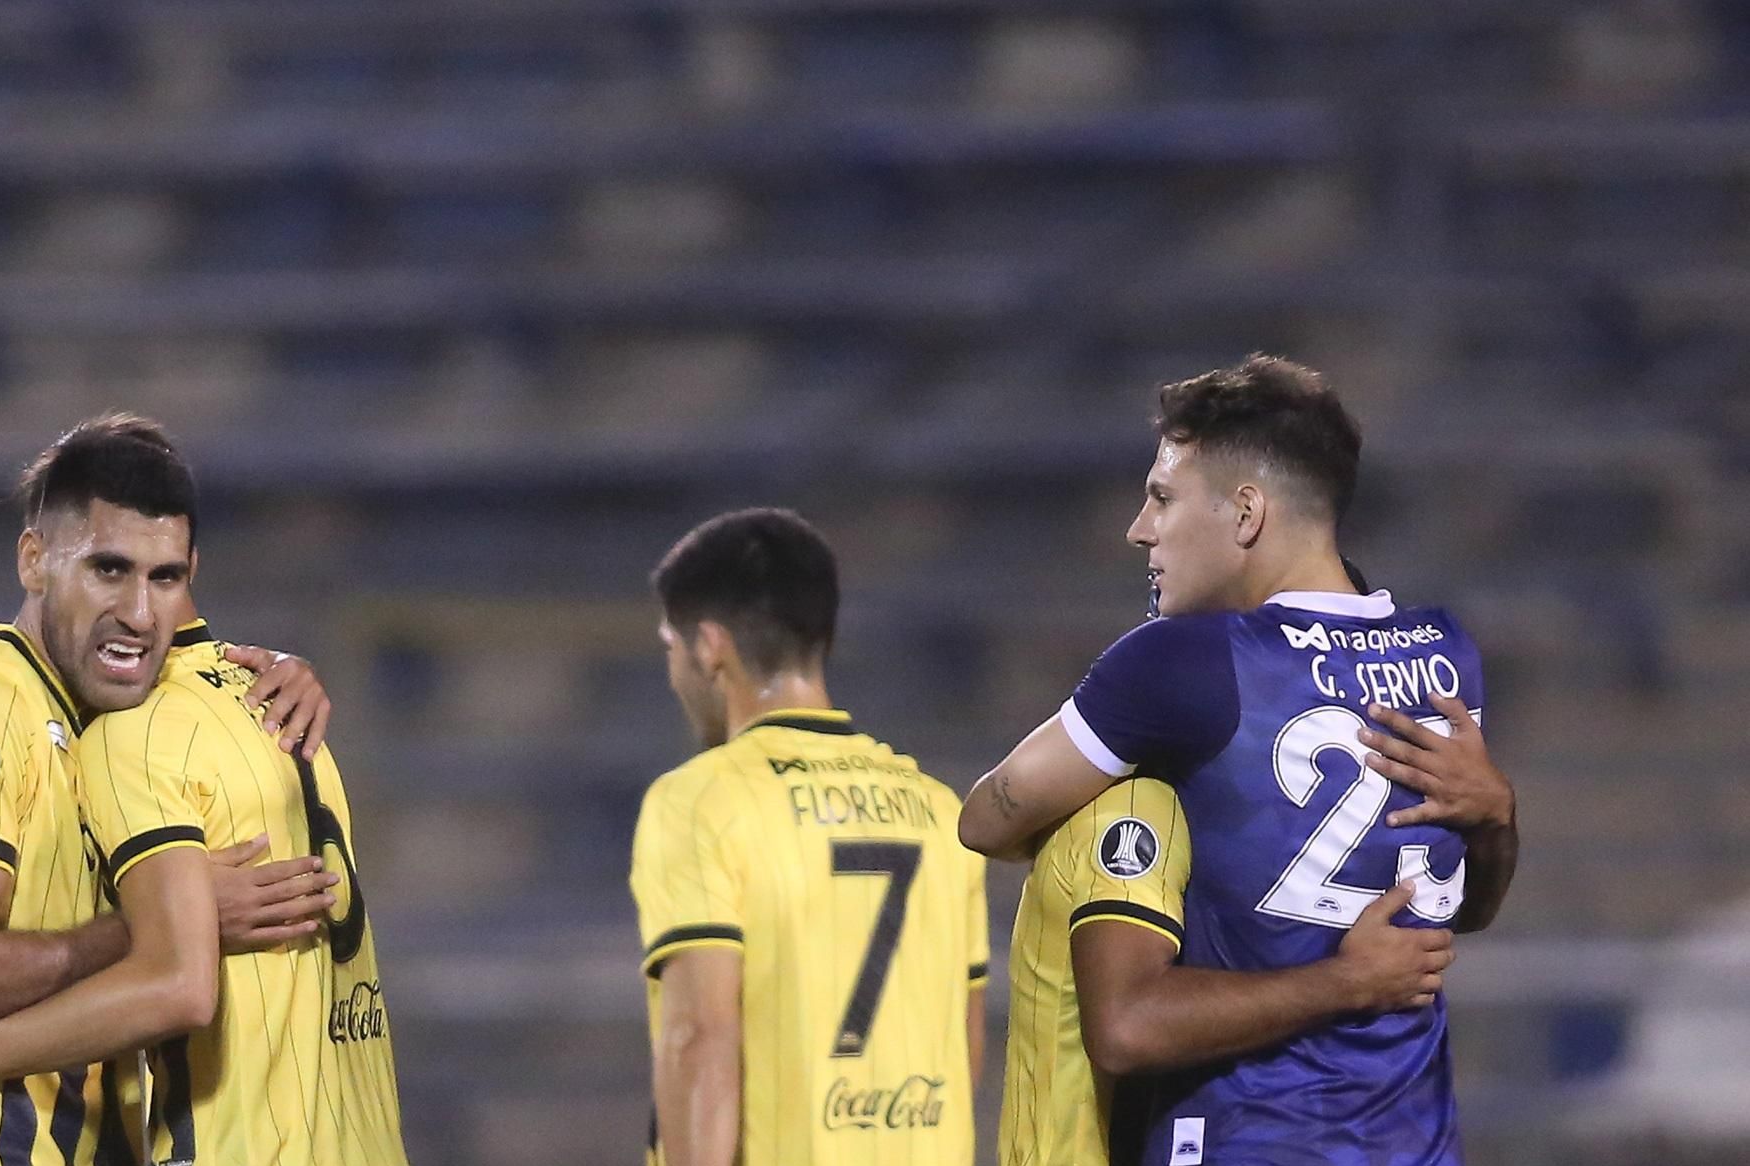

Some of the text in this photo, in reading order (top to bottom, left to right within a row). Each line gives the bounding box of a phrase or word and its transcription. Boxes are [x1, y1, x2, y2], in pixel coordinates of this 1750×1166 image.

[1311, 653, 1459, 709] G. SERVIO
[828, 837, 924, 1058] 7
